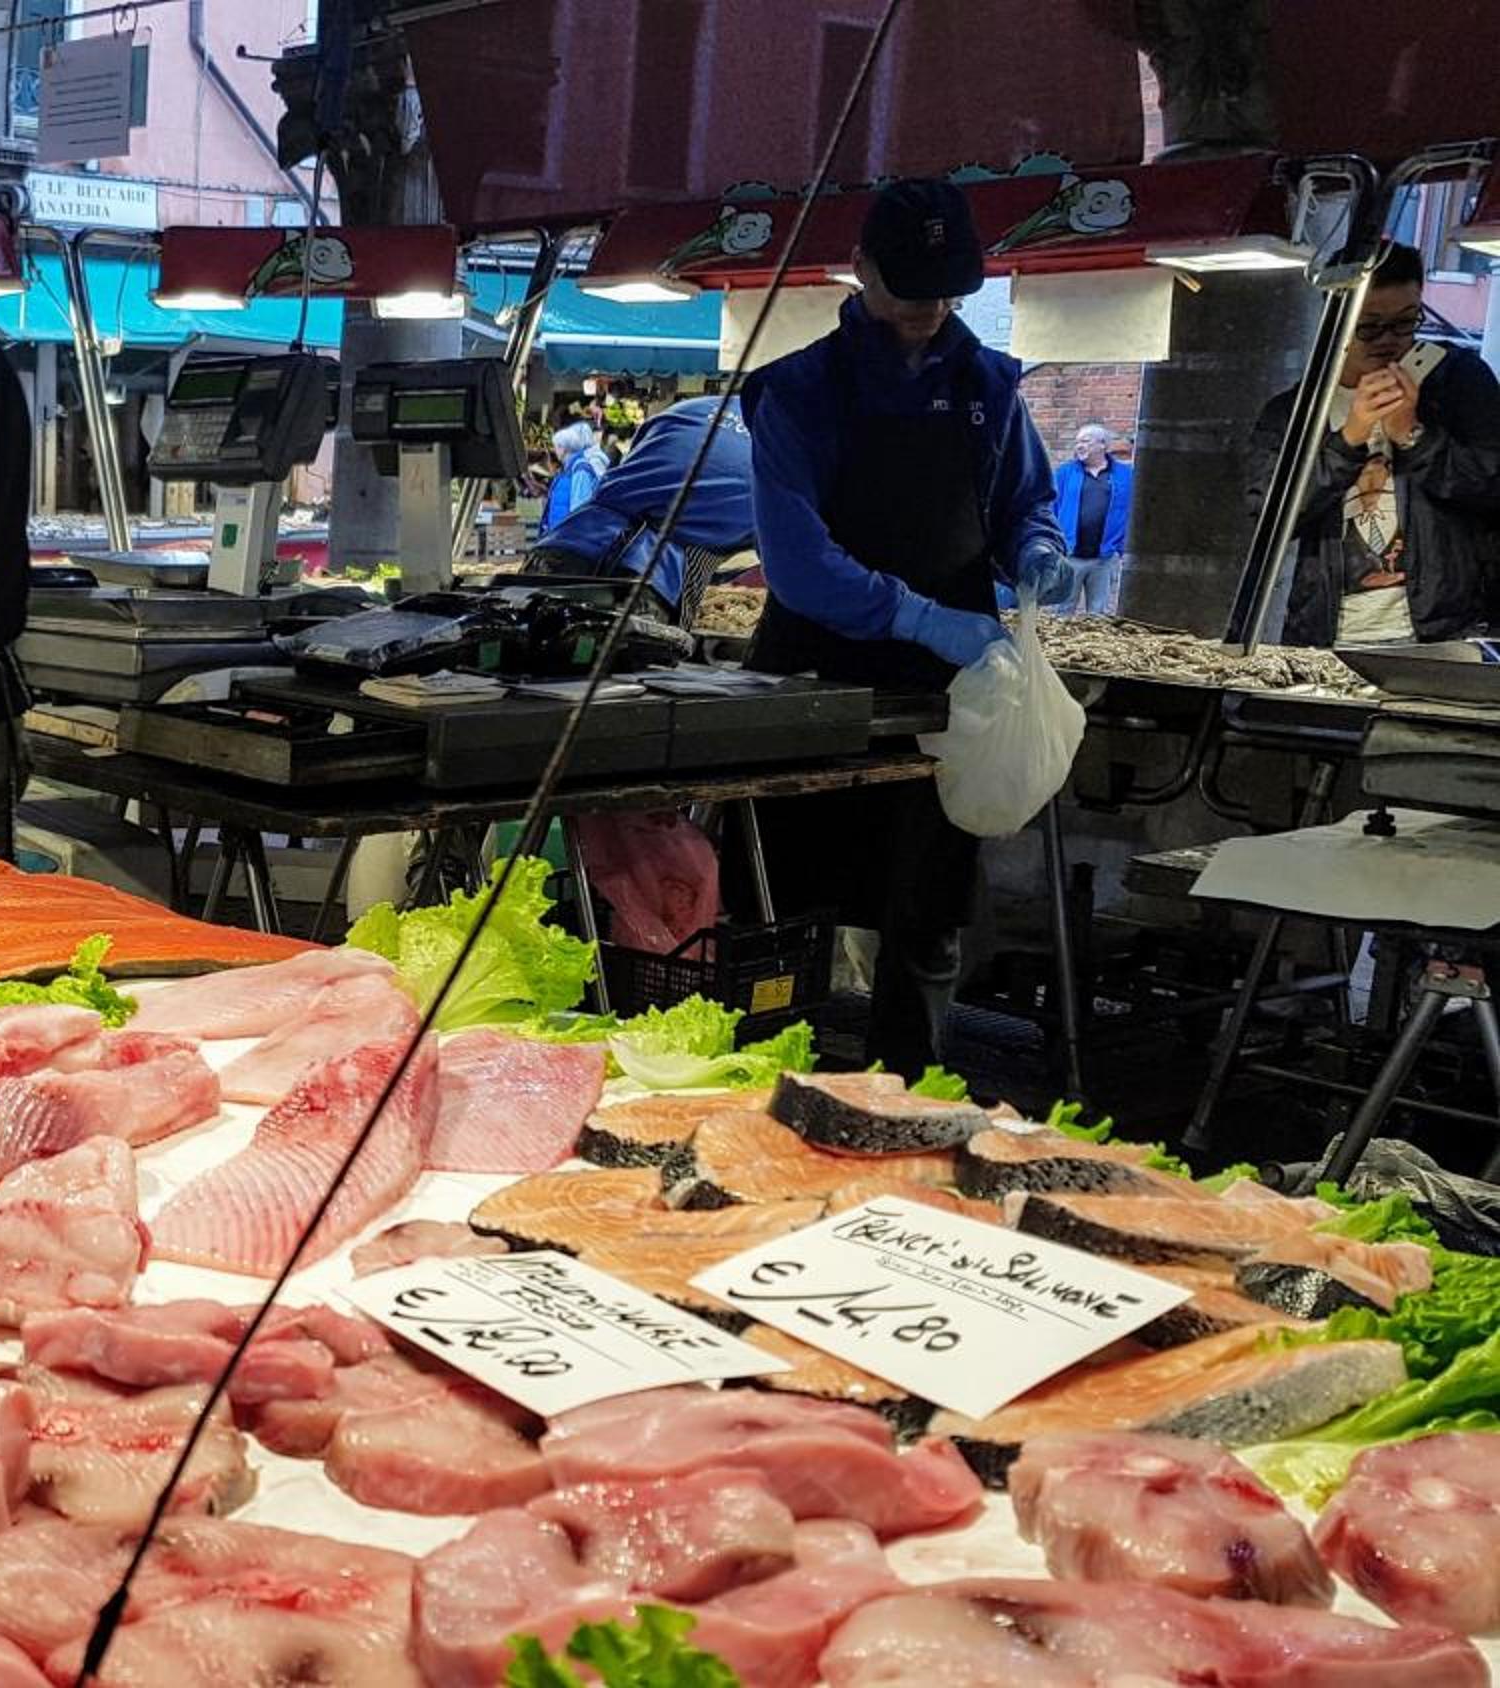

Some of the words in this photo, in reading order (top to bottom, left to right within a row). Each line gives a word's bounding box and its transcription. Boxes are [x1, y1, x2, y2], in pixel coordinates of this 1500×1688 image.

[32, 199, 111, 218] ANATERIA
[750, 1260, 805, 1285] €
[393, 1286, 446, 1310] €
